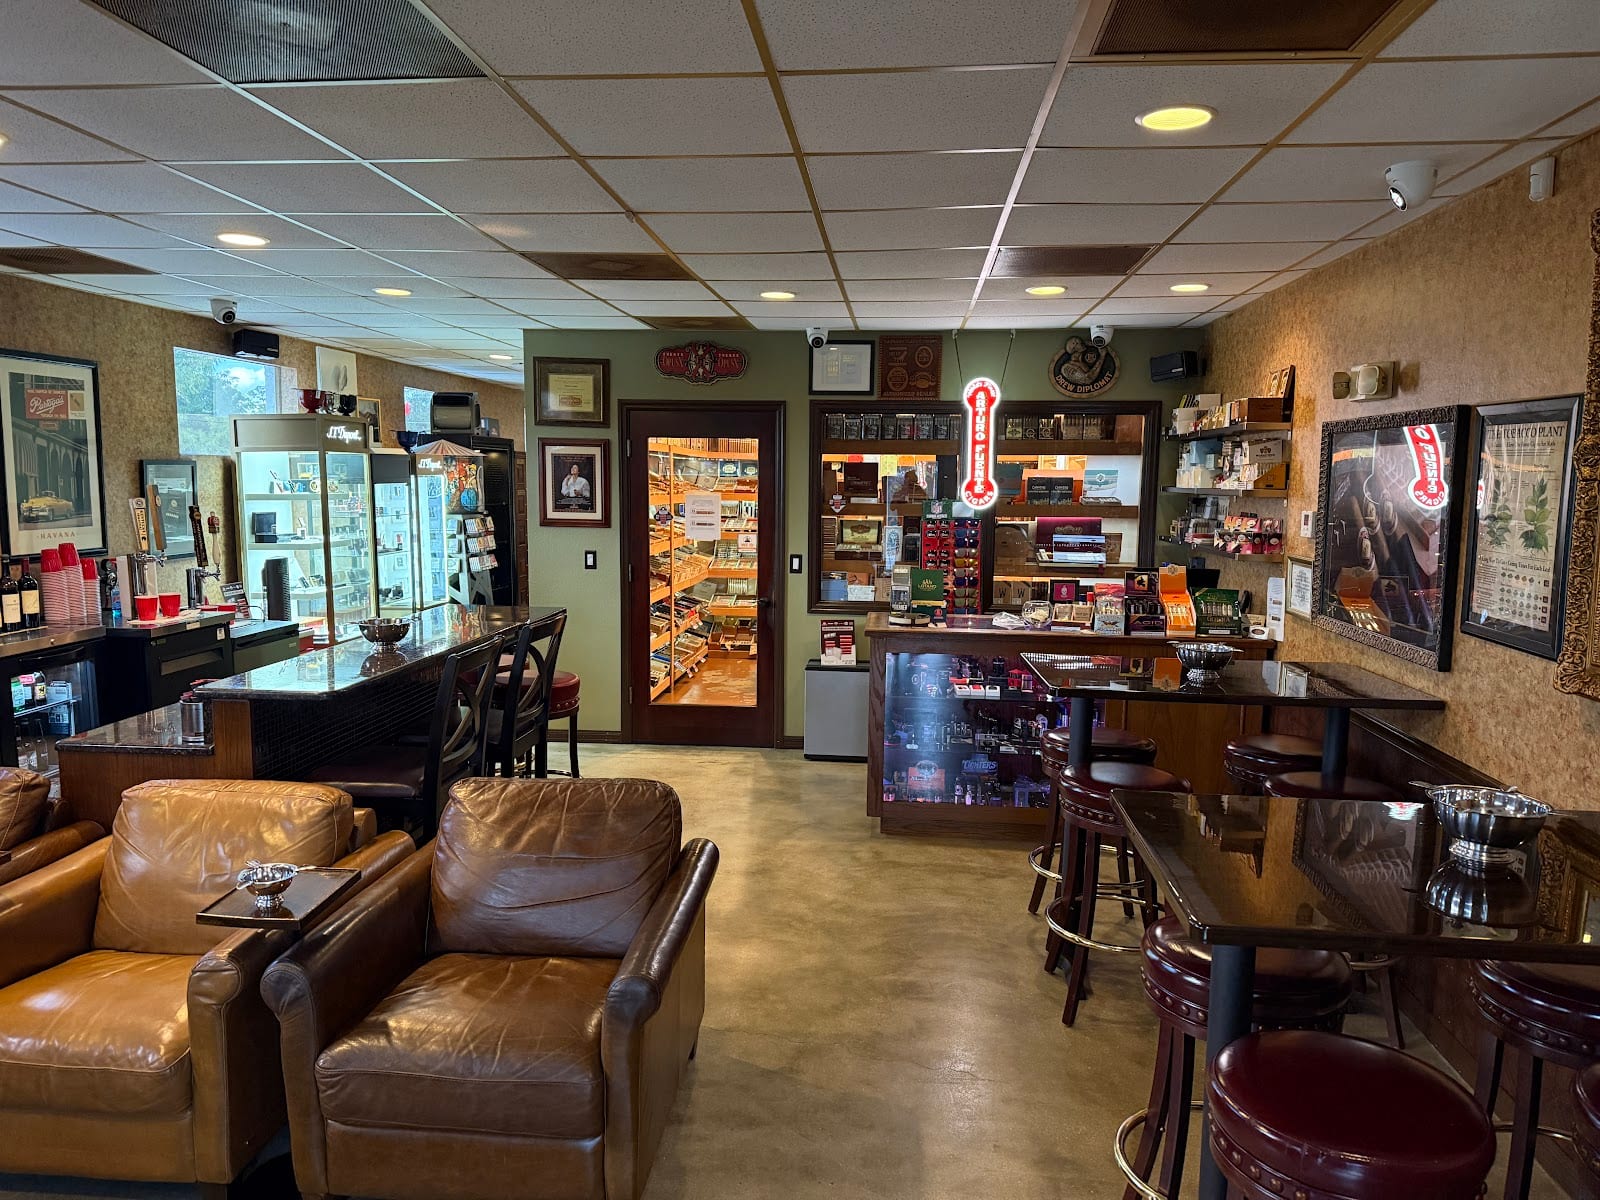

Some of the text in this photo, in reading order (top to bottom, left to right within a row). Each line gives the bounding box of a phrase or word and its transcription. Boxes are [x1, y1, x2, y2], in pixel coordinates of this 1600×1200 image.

[1055, 370, 1113, 393] DREW DIPLOMAT
[1503, 426, 1537, 439] TOBACCO
[1538, 425, 1565, 438] PLANT
[973, 391, 986, 494] ARTURO FUENTE
[965, 490, 994, 506] CIGARS
[40, 531, 76, 539] HAVANA
[963, 760, 997, 770] LIGHTERS
